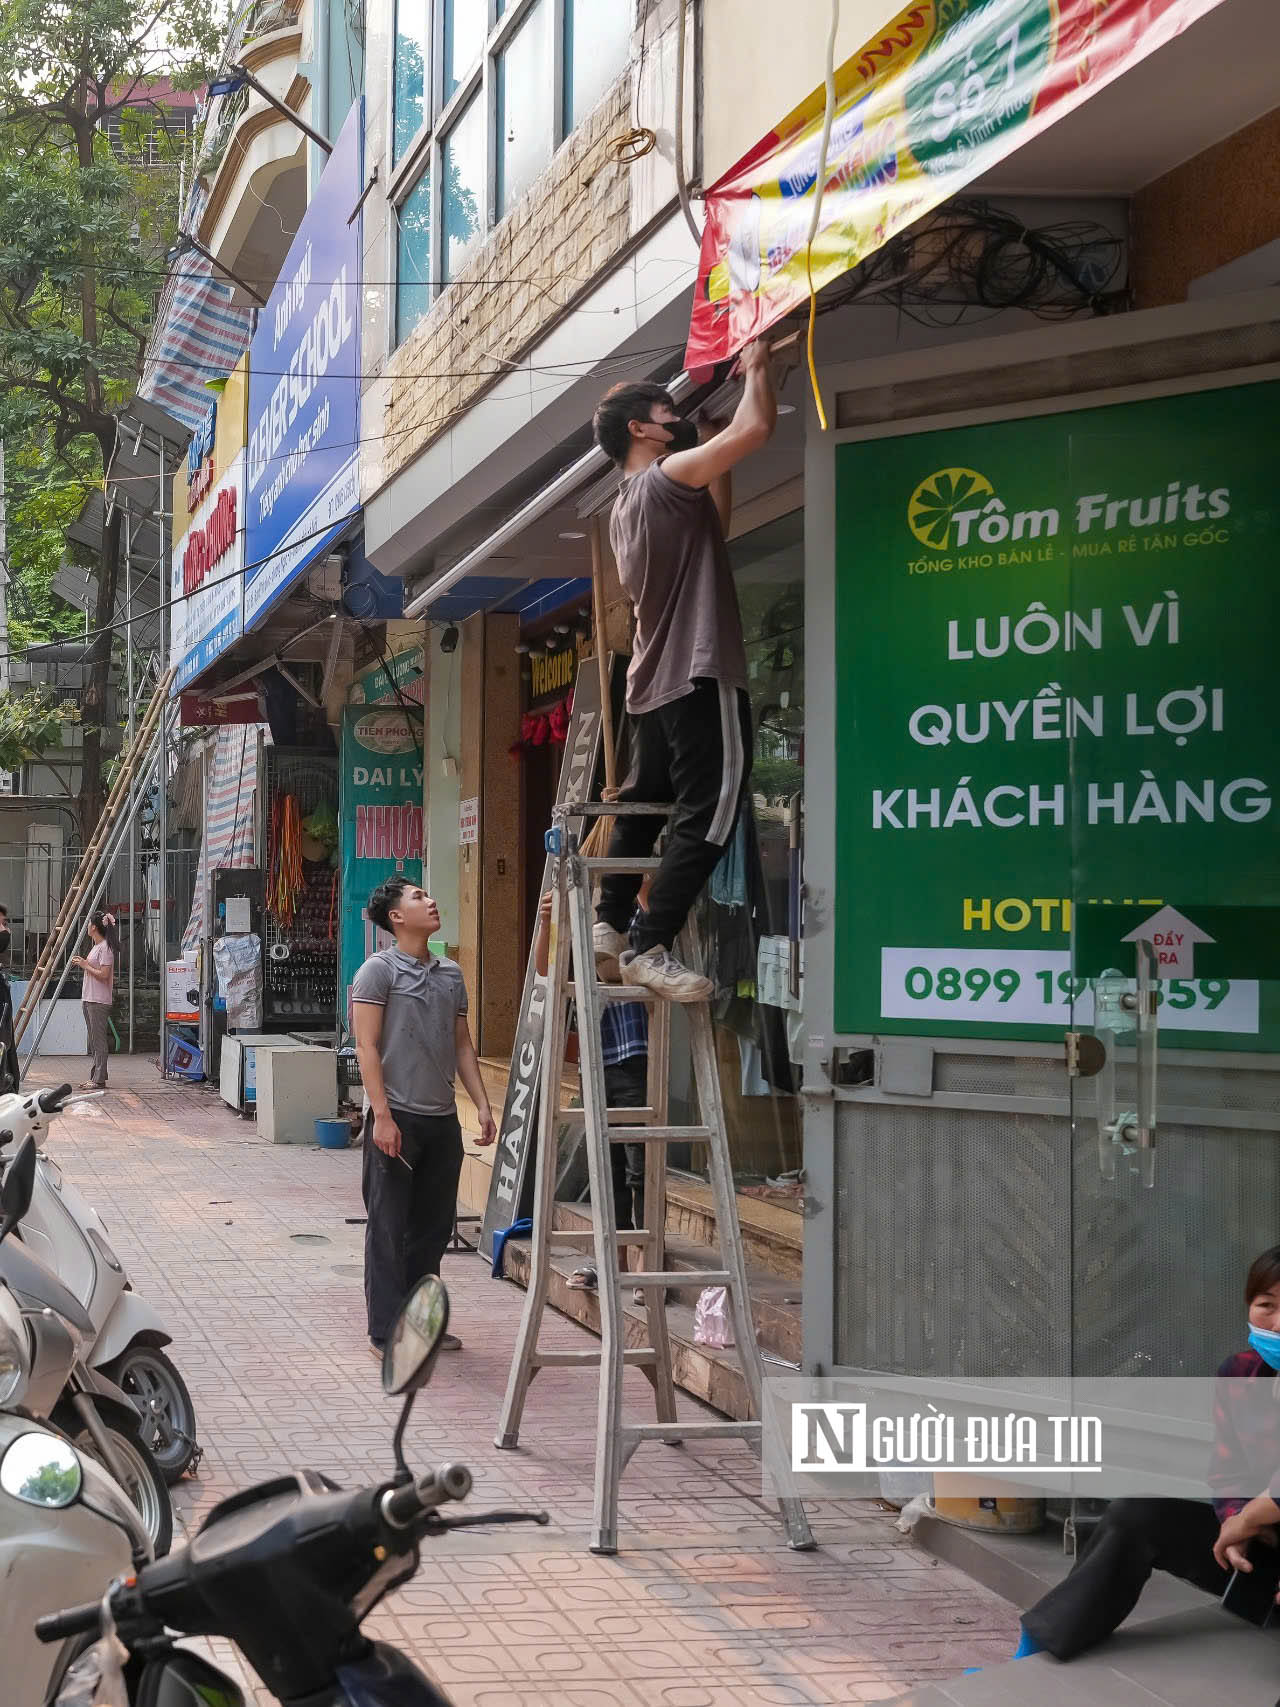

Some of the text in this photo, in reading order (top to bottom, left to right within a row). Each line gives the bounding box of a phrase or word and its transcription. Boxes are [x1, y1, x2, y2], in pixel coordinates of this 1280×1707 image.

[931, 21, 1020, 142] Số 7
[248, 371, 288, 494] CLEVER
[288, 263, 352, 428] SCHOOL
[950, 481, 1230, 548] Tôm Fruits
[908, 555, 953, 575] TỔNG
[958, 554, 992, 570] KHO
[1073, 543, 1113, 558] MUA
[948, 590, 1179, 660] LUÔN VÌ
[908, 682, 1224, 746] QUYỀN LỢI
[352, 767, 393, 792] ĐẠI
[872, 770, 1272, 829] KHÁCH HÀNG
[355, 800, 424, 872] NHỰA
[904, 966, 1021, 1003] 0899
[1159, 952, 1178, 965] RA
[496, 1040, 535, 1201] HÀNG
